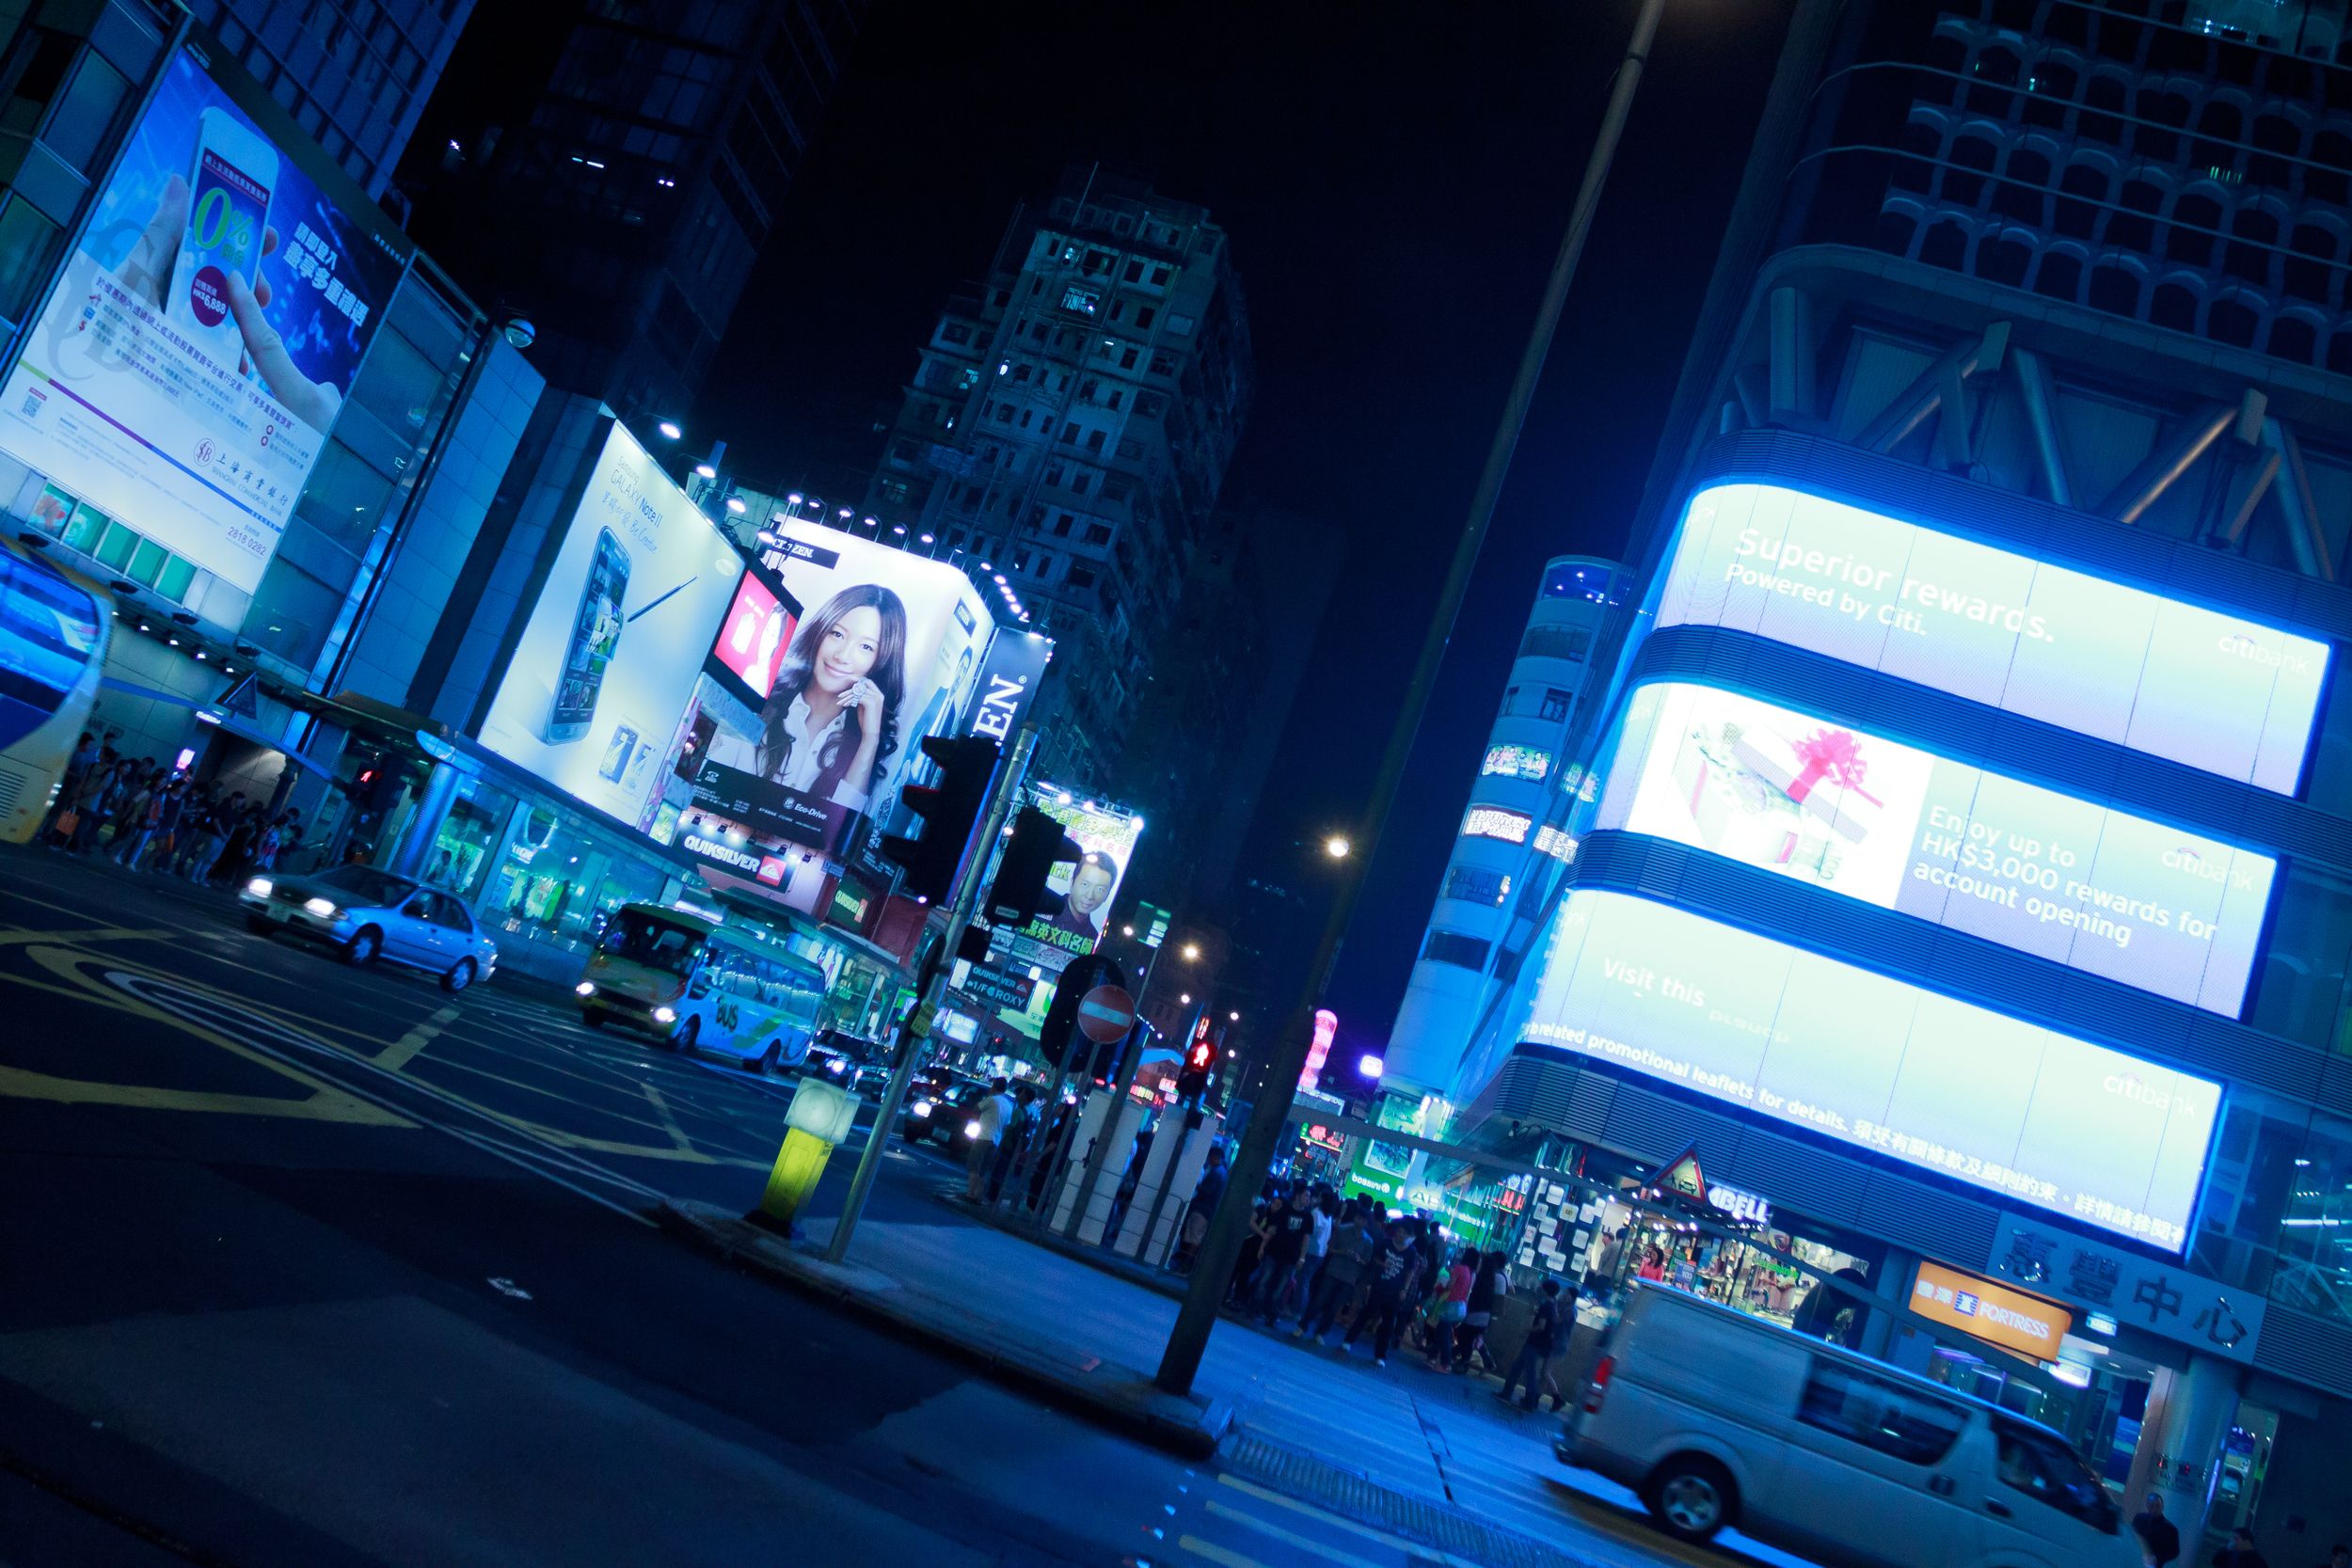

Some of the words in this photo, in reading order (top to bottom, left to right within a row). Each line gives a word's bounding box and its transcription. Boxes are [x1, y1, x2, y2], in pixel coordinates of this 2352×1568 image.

[194, 187, 253, 250] 0%
[215, 452, 289, 506] 上海商業銀行
[610, 469, 642, 508] GALAXY
[638, 497, 657, 524] Note
[616, 455, 640, 484] Samsung
[228, 526, 247, 545] 2818
[247, 538, 267, 556] 0282
[1724, 562, 1835, 610] Powered
[1836, 594, 1870, 623] by
[1875, 603, 1931, 636] Citi.
[1731, 525, 1893, 596] Superior
[1899, 574, 2061, 644] rewards.
[2217, 630, 2312, 675] citibank
[794, 802, 828, 821] Eco-Drive
[1925, 805, 2004, 850] Enjoy
[2006, 832, 2045, 863] up
[2046, 843, 2078, 869] to
[683, 833, 761, 873] QUIKSILVER
[1910, 861, 2020, 911] account
[2021, 895, 2134, 950] opening
[1917, 832, 2060, 895] HK$3,000
[2062, 878, 2173, 928] rewards
[2175, 911, 2219, 942] for
[994, 989, 1025, 1007] ROXY
[1600, 957, 1657, 992] Visit
[1661, 974, 1708, 1008] this
[1538, 1023, 1585, 1044] related
[1585, 1032, 1692, 1080] promotional
[1690, 1065, 1757, 1100] leaflets
[1757, 1087, 1786, 1109] for
[1785, 1097, 1851, 1132] details.
[1350, 1171, 1382, 1190] bossini
[2000, 1228, 2249, 1349] 惠豐中心
[1979, 1300, 2050, 1340] FORTRESS
